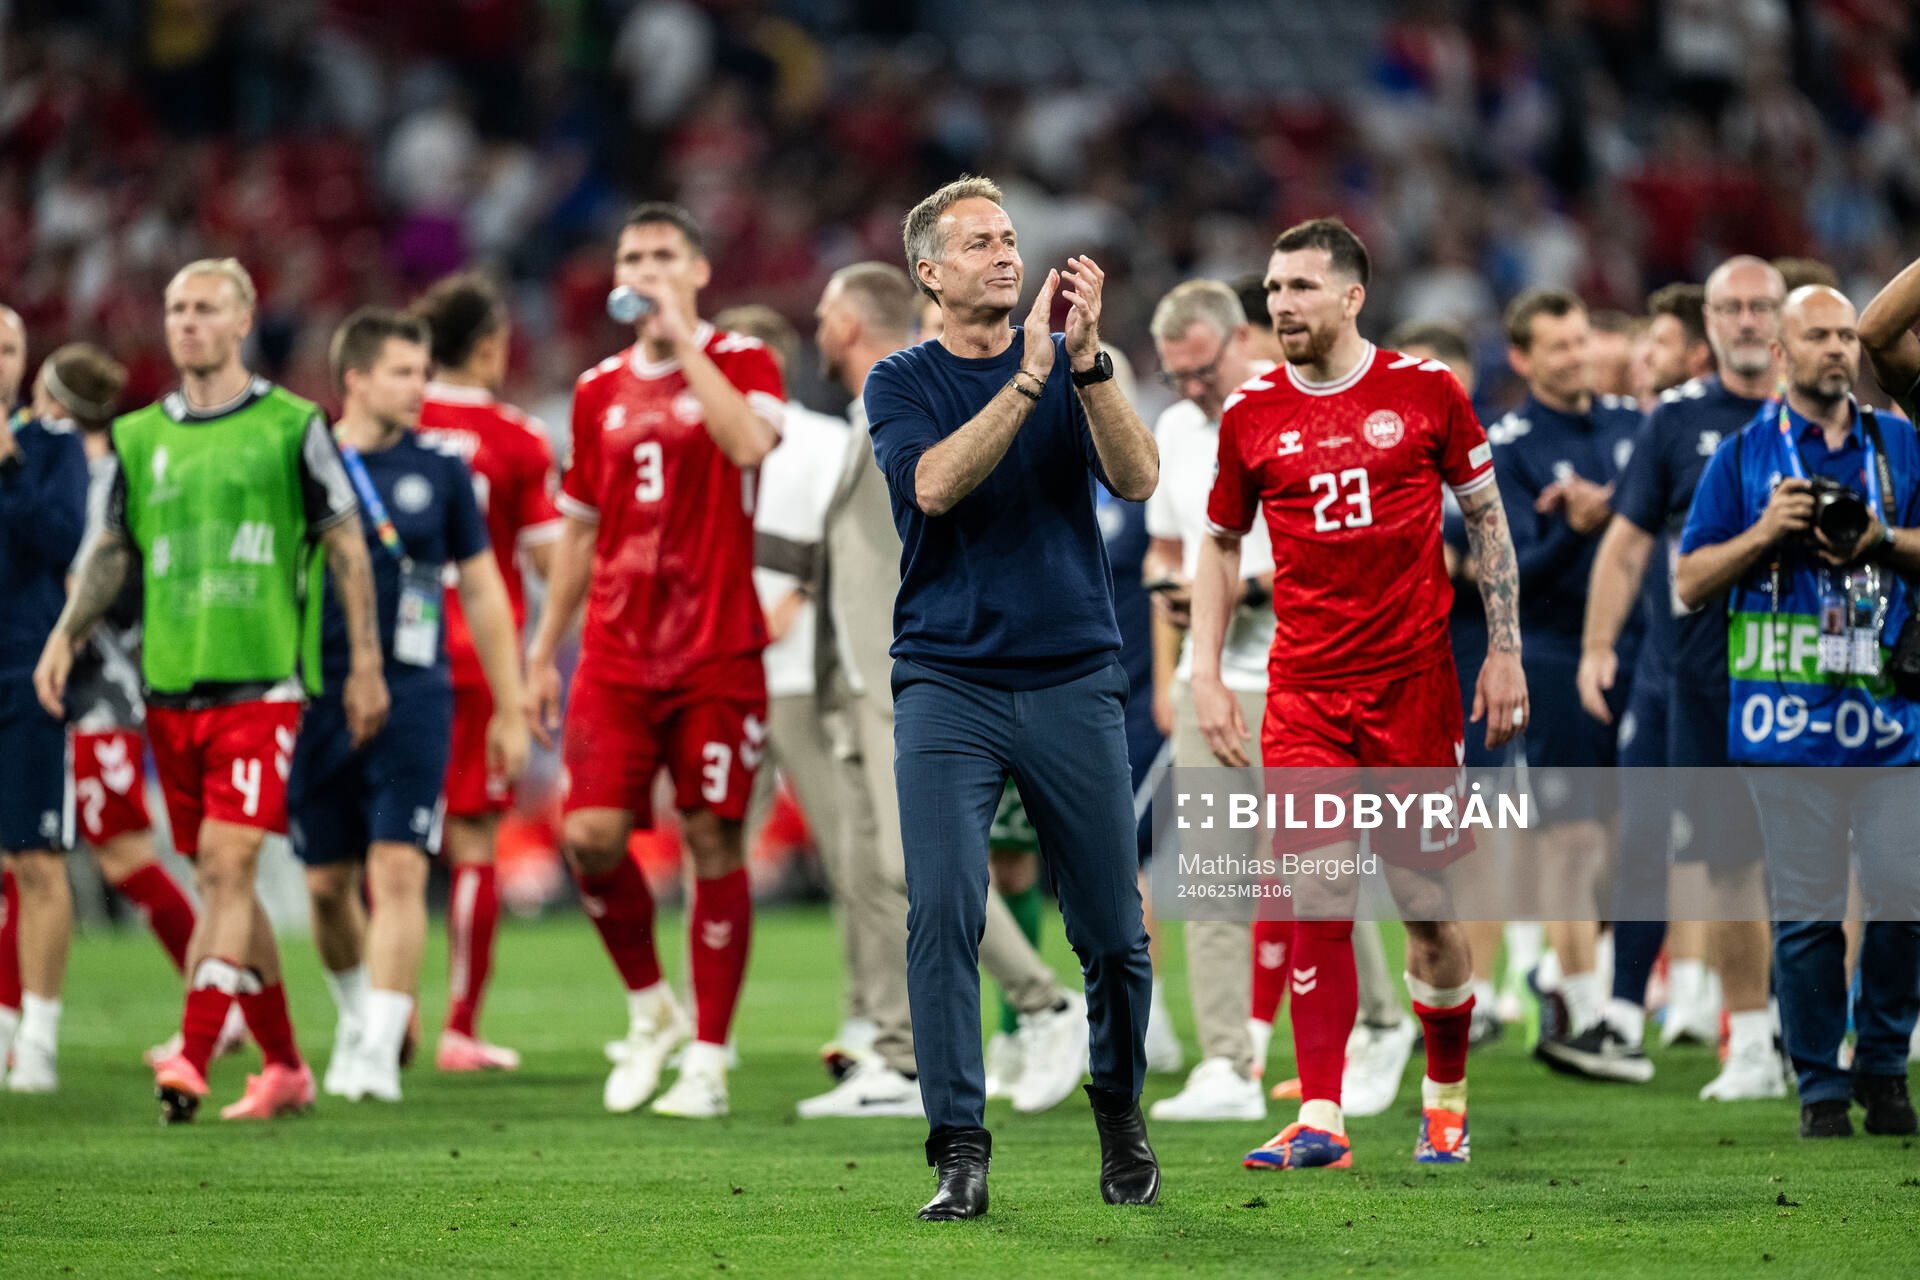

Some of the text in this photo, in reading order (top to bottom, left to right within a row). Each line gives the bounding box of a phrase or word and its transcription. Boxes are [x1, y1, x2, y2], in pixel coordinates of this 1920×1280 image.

[633, 441, 665, 503] 3
[1309, 467, 1373, 533] 23
[1741, 693, 1904, 749] 09-09
[231, 757, 262, 817] 4
[701, 741, 732, 804] 3
